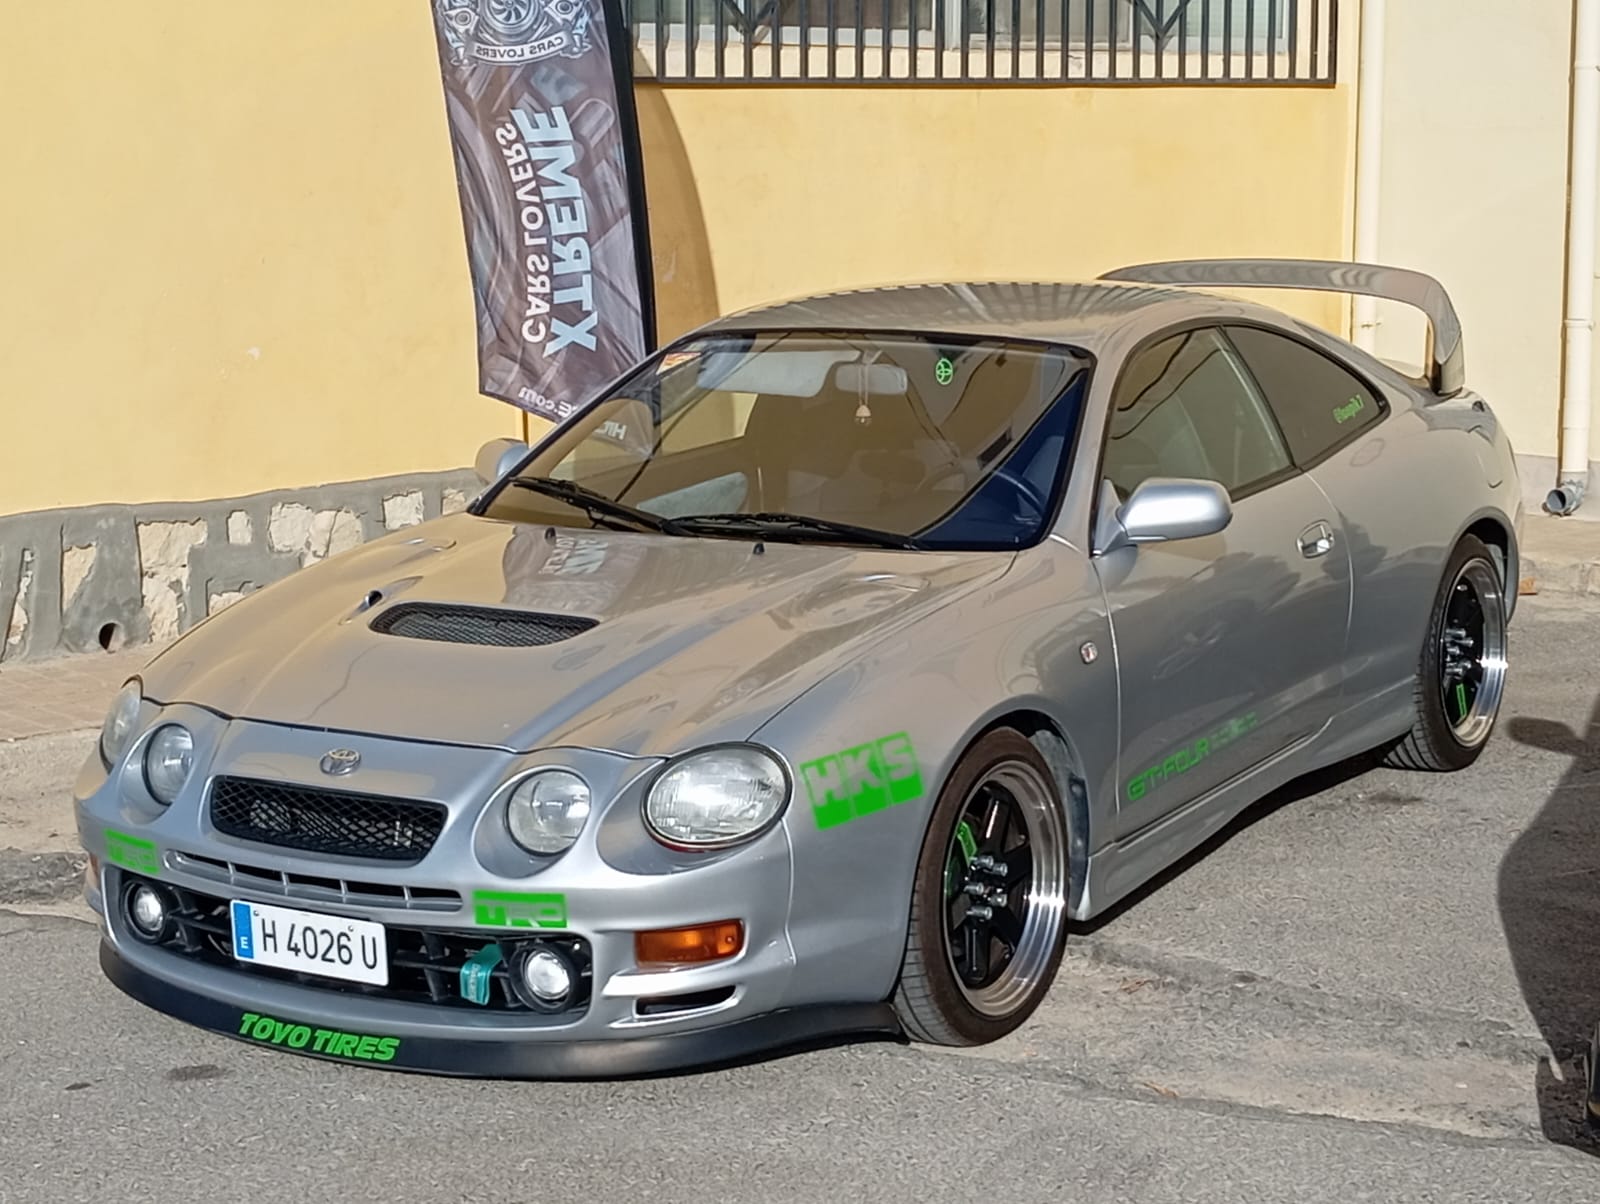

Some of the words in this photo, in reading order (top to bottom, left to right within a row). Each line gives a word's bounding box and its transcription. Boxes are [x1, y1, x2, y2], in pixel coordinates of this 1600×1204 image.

[802, 734, 920, 812] HKS
[240, 936, 249, 949] E
[261, 917, 278, 954] H
[287, 922, 353, 966] 4026
[361, 934, 378, 970] U
[239, 1012, 312, 1048] TOYO
[312, 1029, 400, 1061] TIRES
